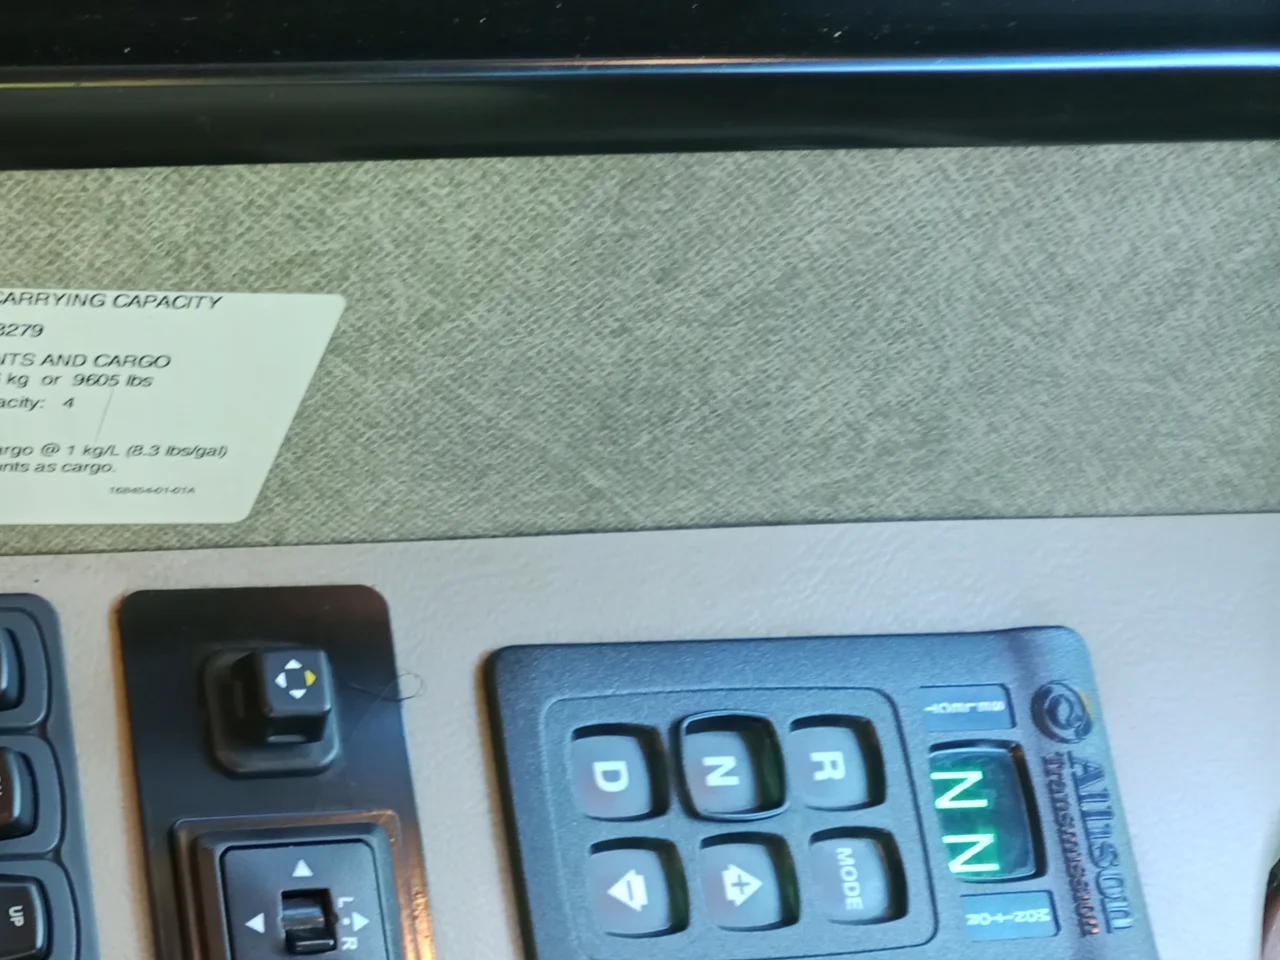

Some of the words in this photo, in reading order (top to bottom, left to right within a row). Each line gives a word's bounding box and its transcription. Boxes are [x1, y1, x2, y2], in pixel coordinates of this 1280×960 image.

[113, 294, 224, 308] CAPACITY
[41, 353, 87, 367] AND
[93, 353, 172, 368] CARGO
[6, 373, 29, 387] kg
[42, 376, 62, 386] or
[72, 373, 120, 386] 9605
[126, 374, 153, 386] lbs
[592, 760, 629, 793] D
[701, 755, 740, 787] N
[809, 751, 846, 782] R
[930, 770, 988, 810] N
[941, 833, 1000, 873] N
[1042, 752, 1100, 936] Transmission
[1069, 750, 1132, 934] Allison
[835, 847, 864, 911] MODE
[8, 905, 25, 927] UP
[338, 896, 354, 909] L
[965, 908, 1051, 926] MONITOR
[341, 937, 358, 951] R
